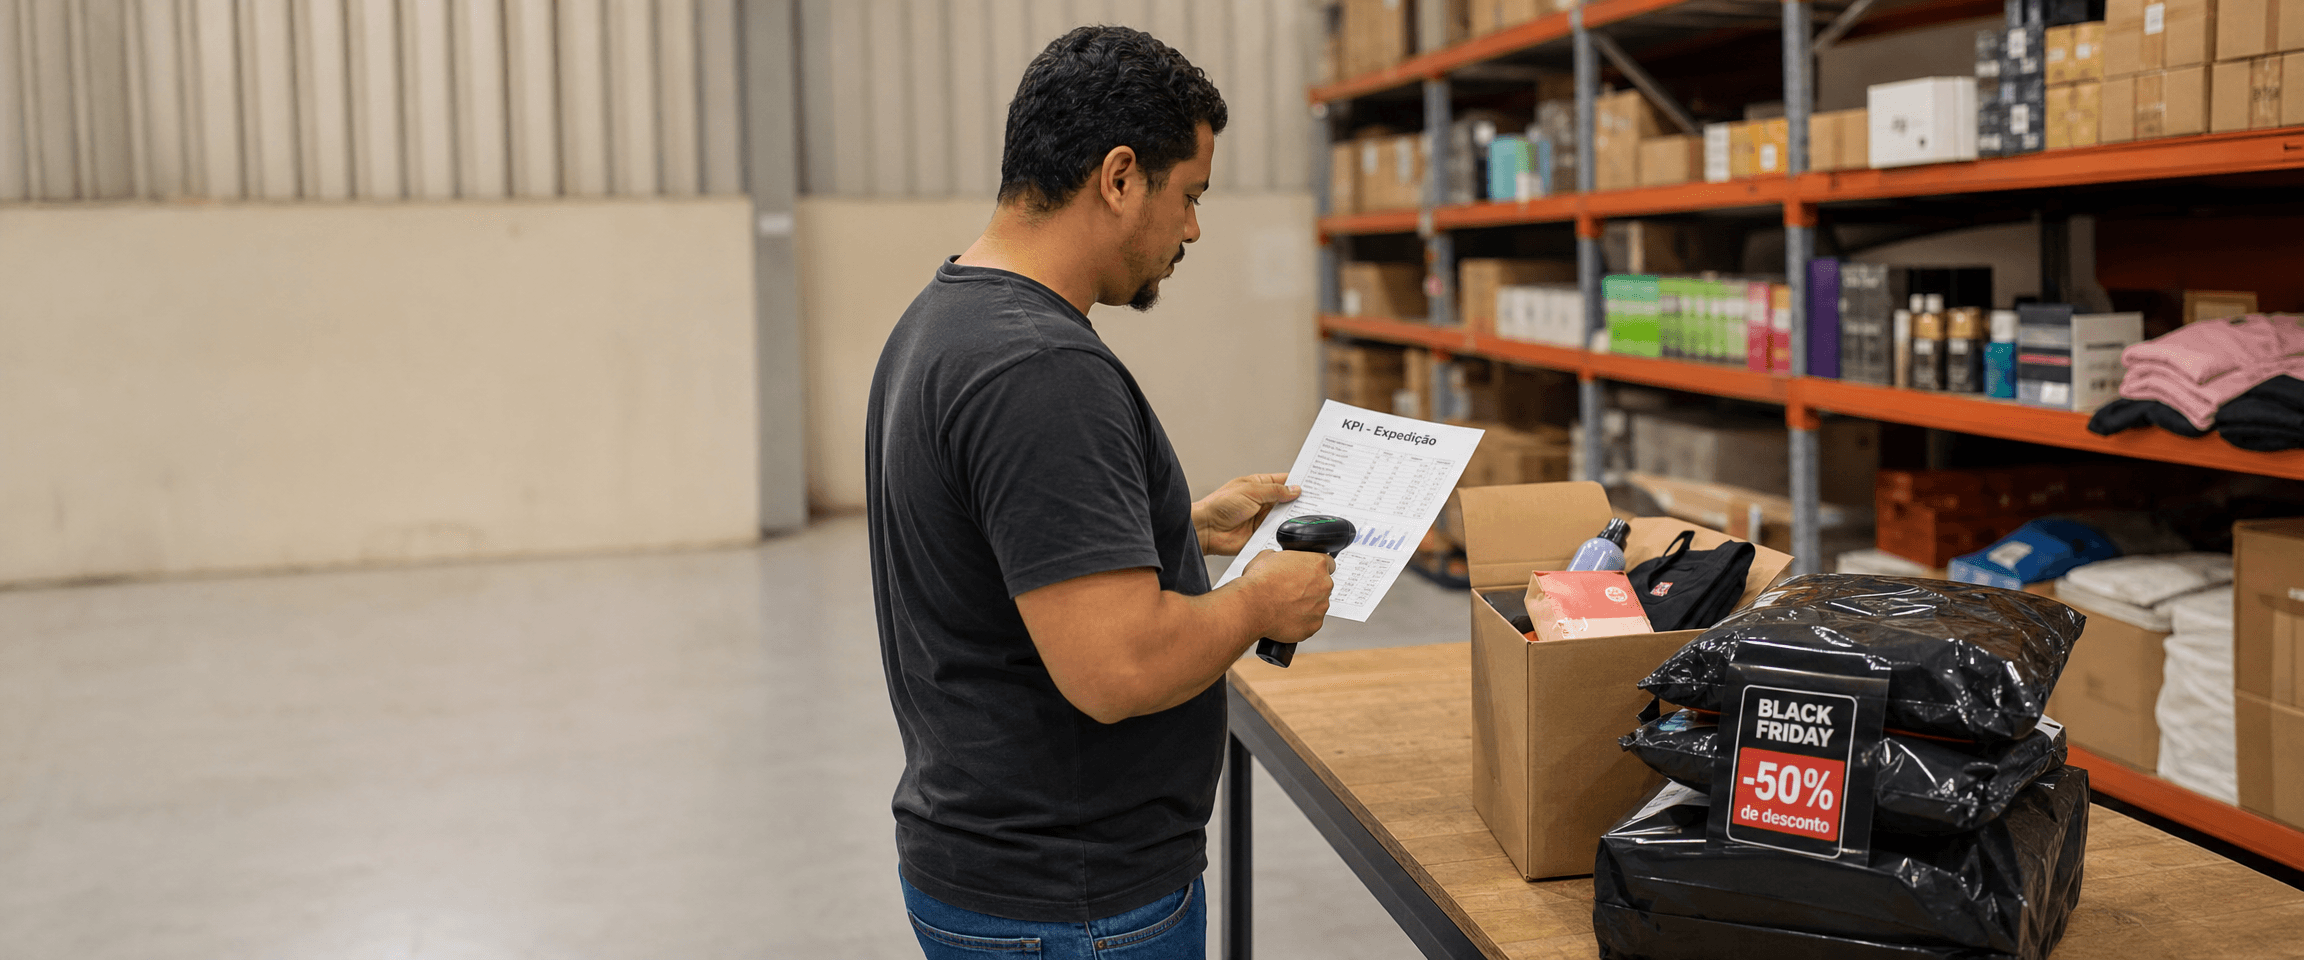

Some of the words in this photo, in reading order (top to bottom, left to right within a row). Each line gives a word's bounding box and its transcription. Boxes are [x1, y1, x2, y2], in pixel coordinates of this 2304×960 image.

[1341, 418, 1365, 432] KPI
[1373, 425, 1437, 446] Expedição
[1758, 698, 1833, 726] BLACK
[1756, 720, 1834, 748] FRIDAY
[1742, 760, 1834, 811] -50%
[1741, 804, 1758, 821] de
[1761, 808, 1829, 833] desconto
